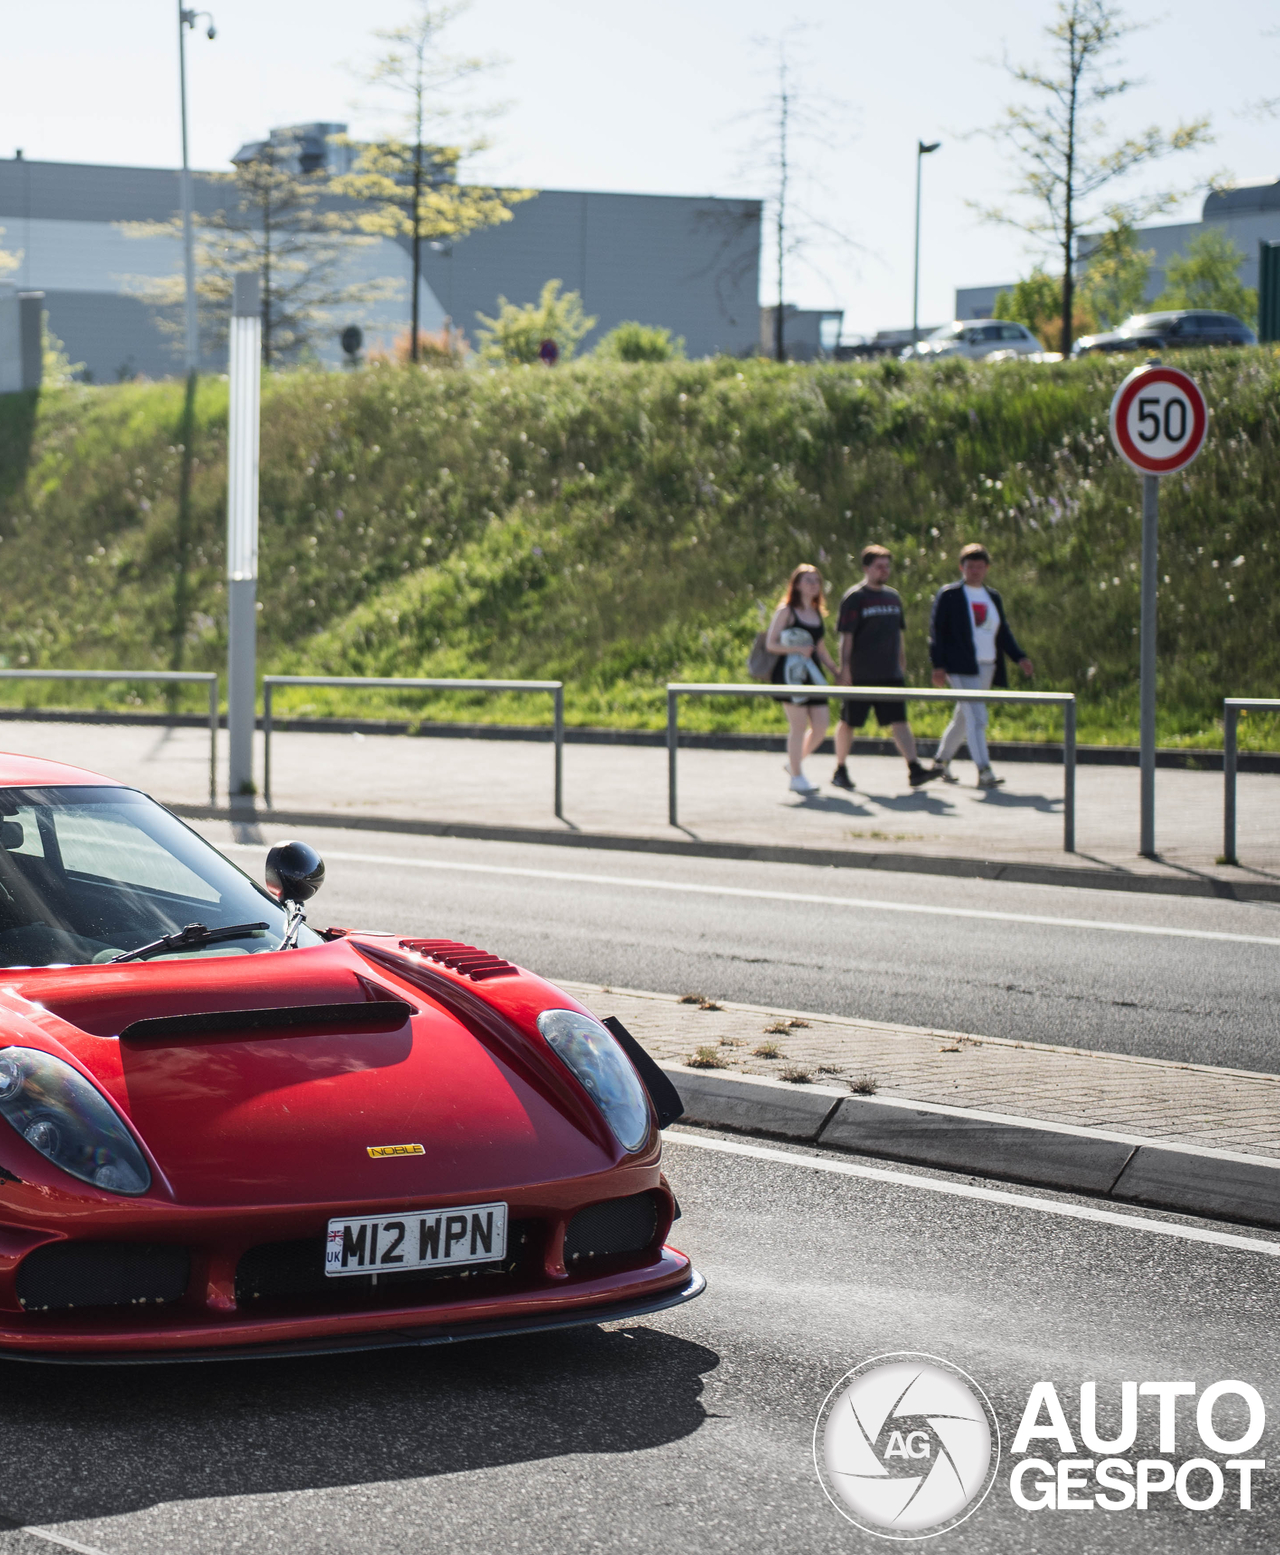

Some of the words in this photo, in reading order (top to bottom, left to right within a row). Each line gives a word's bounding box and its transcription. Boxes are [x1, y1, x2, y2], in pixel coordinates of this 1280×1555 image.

[1138, 397, 1187, 443] 50
[371, 1145, 424, 1156] NOBLE
[341, 1221, 406, 1268] M12
[419, 1211, 494, 1261] WPN
[327, 1251, 341, 1263] UK
